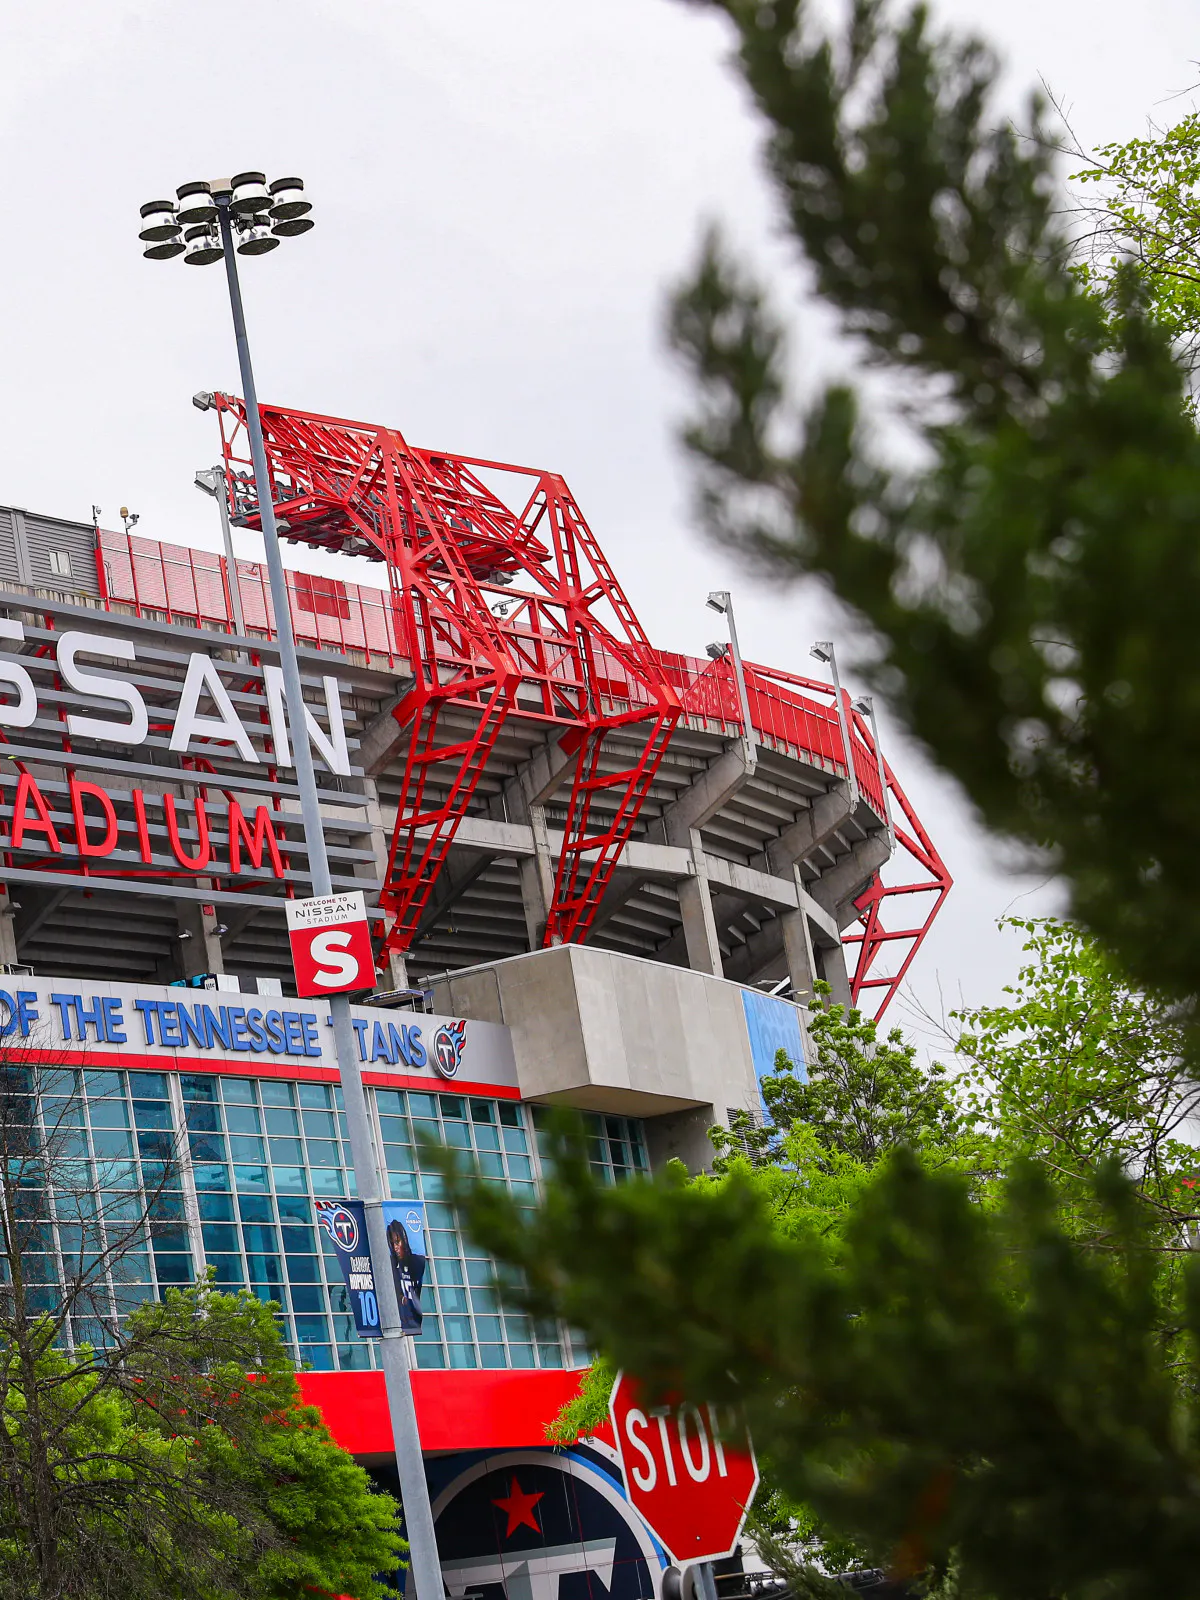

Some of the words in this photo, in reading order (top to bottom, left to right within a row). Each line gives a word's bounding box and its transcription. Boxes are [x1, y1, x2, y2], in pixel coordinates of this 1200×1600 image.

[295, 902, 357, 918] NISSAN
[302, 898, 336, 907] WELCOME
[306, 913, 349, 924] STADIUM
[310, 930, 359, 987] S
[50, 993, 128, 1043] THE
[135, 999, 322, 1057] TENNESSEE
[326, 1014, 427, 1067] TANS
[349, 1274, 374, 1290] HOPKINS
[358, 1291, 379, 1327] 10
